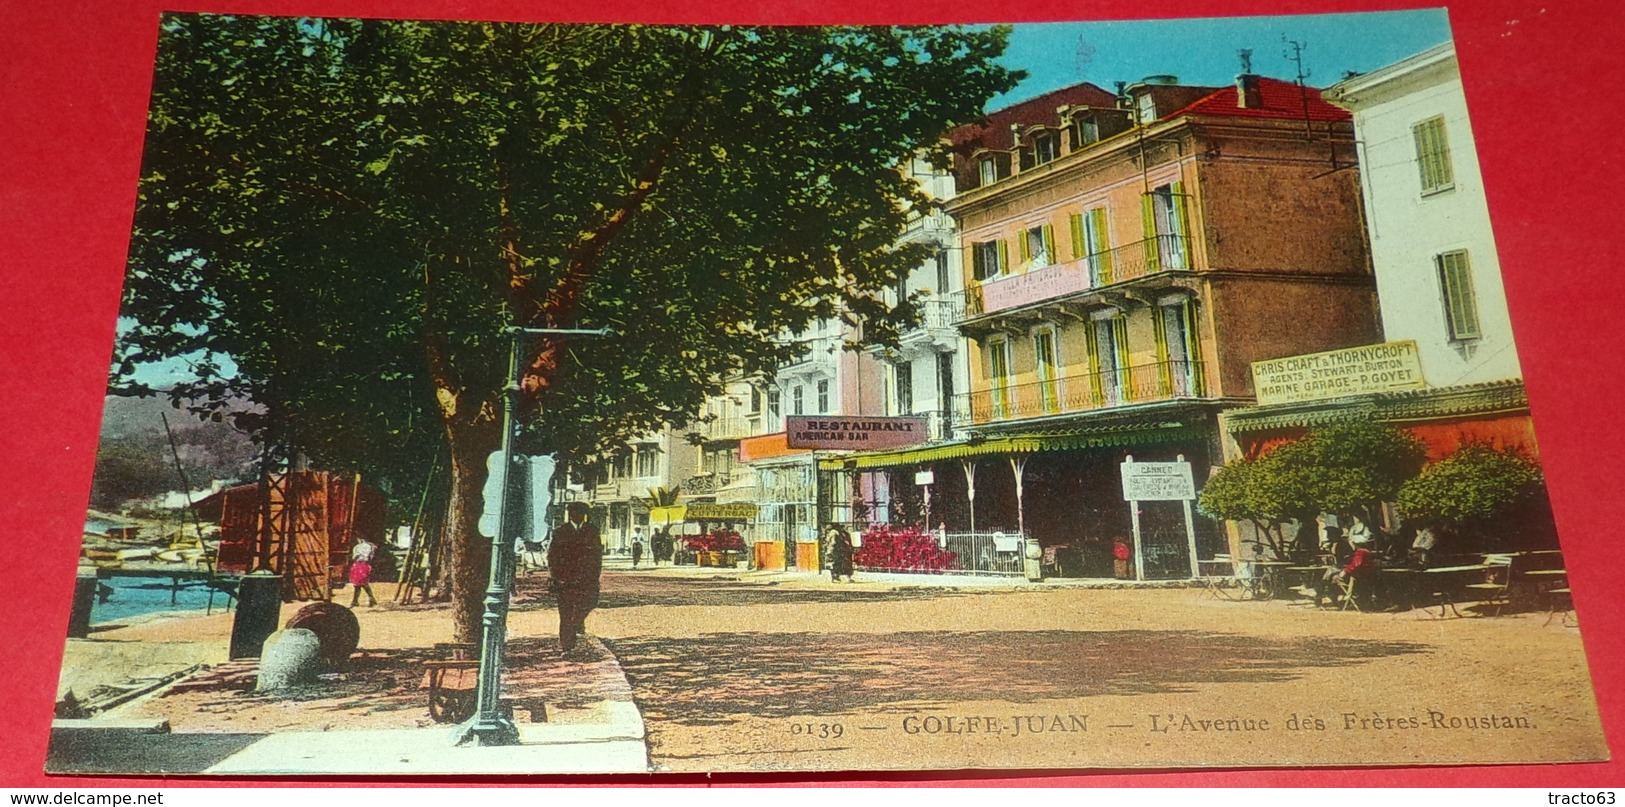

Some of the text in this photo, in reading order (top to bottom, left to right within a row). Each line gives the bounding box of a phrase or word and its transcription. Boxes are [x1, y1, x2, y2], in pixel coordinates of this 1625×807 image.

[1255, 361, 1284, 376] CHRIS
[1287, 356, 1320, 371] CRAFT
[1330, 344, 1412, 366] THORNYCROFT
[1311, 364, 1359, 379] STEWART
[1365, 359, 1403, 371] BURTON
[1261, 384, 1299, 397] MARINE
[1304, 376, 1350, 391] GARAGE
[1372, 369, 1413, 383] GOYET
[795, 431, 869, 441] AMERICAN BAR
[807, 420, 914, 432] RESTAURANT
[902, 714, 1090, 737] GOLFE-JUAN
[1150, 712, 1270, 734] L'Avenue
[1286, 712, 1326, 732] des
